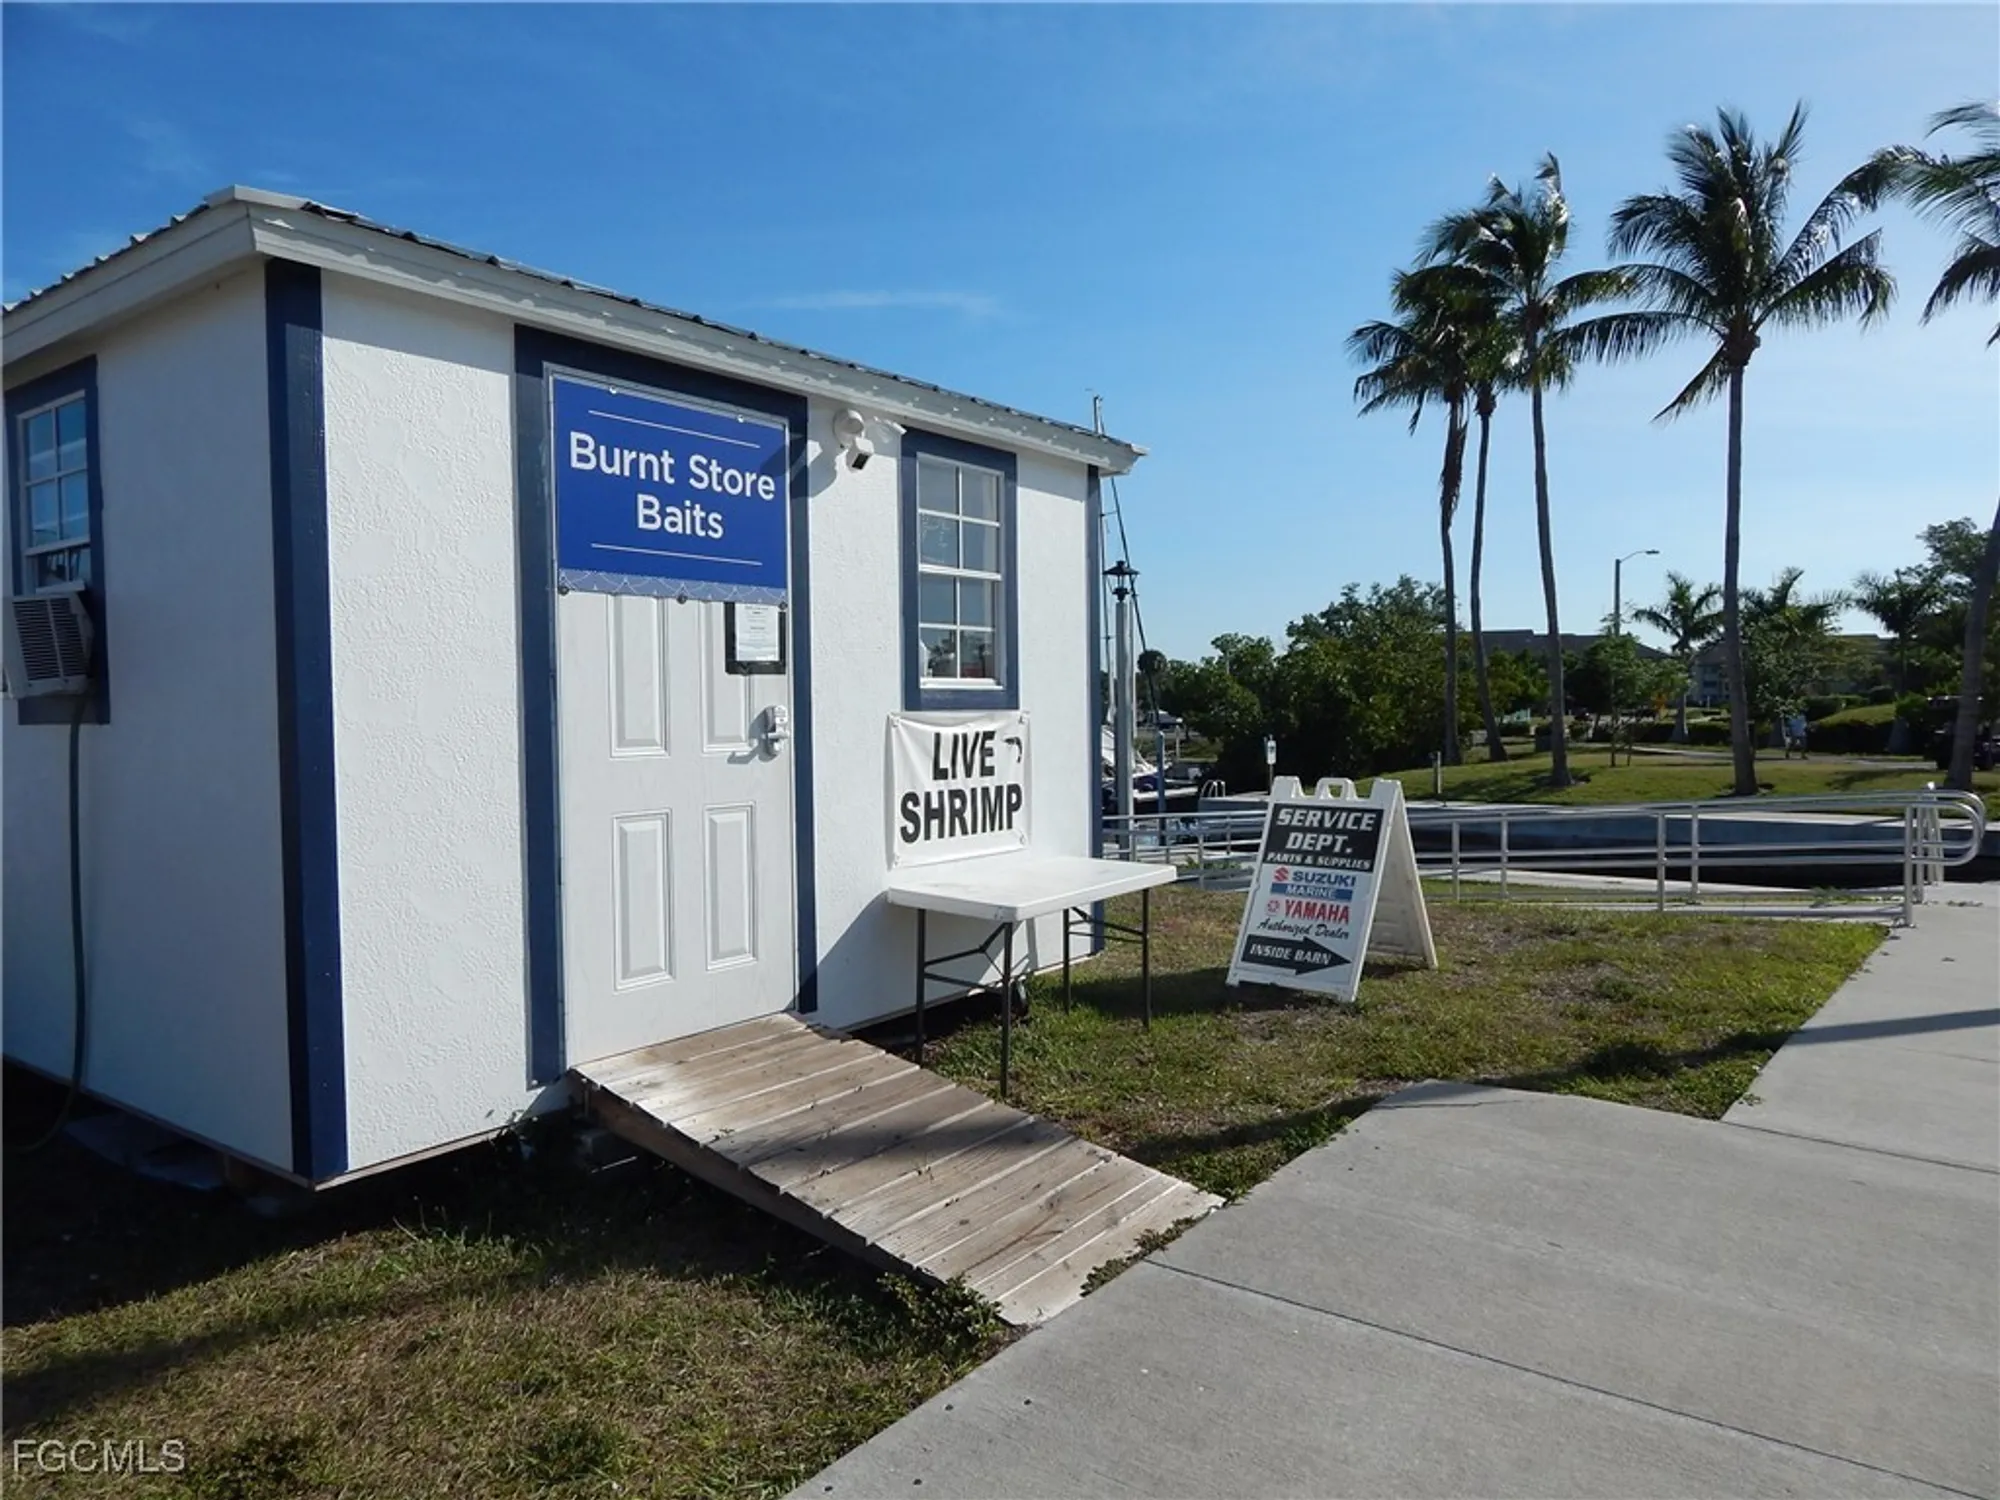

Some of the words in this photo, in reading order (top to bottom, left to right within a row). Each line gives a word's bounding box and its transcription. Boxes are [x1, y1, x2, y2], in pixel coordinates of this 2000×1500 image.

[570, 430, 675, 485] Burnt
[689, 454, 775, 501] Store
[636, 493, 724, 539] Baits
[932, 730, 996, 781] LIVE
[900, 783, 1022, 844] SHRIMP
[1276, 807, 1377, 831] SERVICE
[1285, 831, 1353, 854] DEPT.
[1266, 852, 1300, 864] PARTS
[1303, 855, 1313, 865] &
[1317, 855, 1371, 870] SUPPLIES
[1292, 871, 1356, 887] SUZUKI
[1285, 884, 1337, 899] MARINE
[1284, 899, 1350, 923] YAMAHA
[1257, 918, 1311, 937] Authorized
[1314, 924, 1349, 939] Dealer
[1250, 943, 1291, 960] INSIDE
[1294, 948, 1332, 966] BARN
